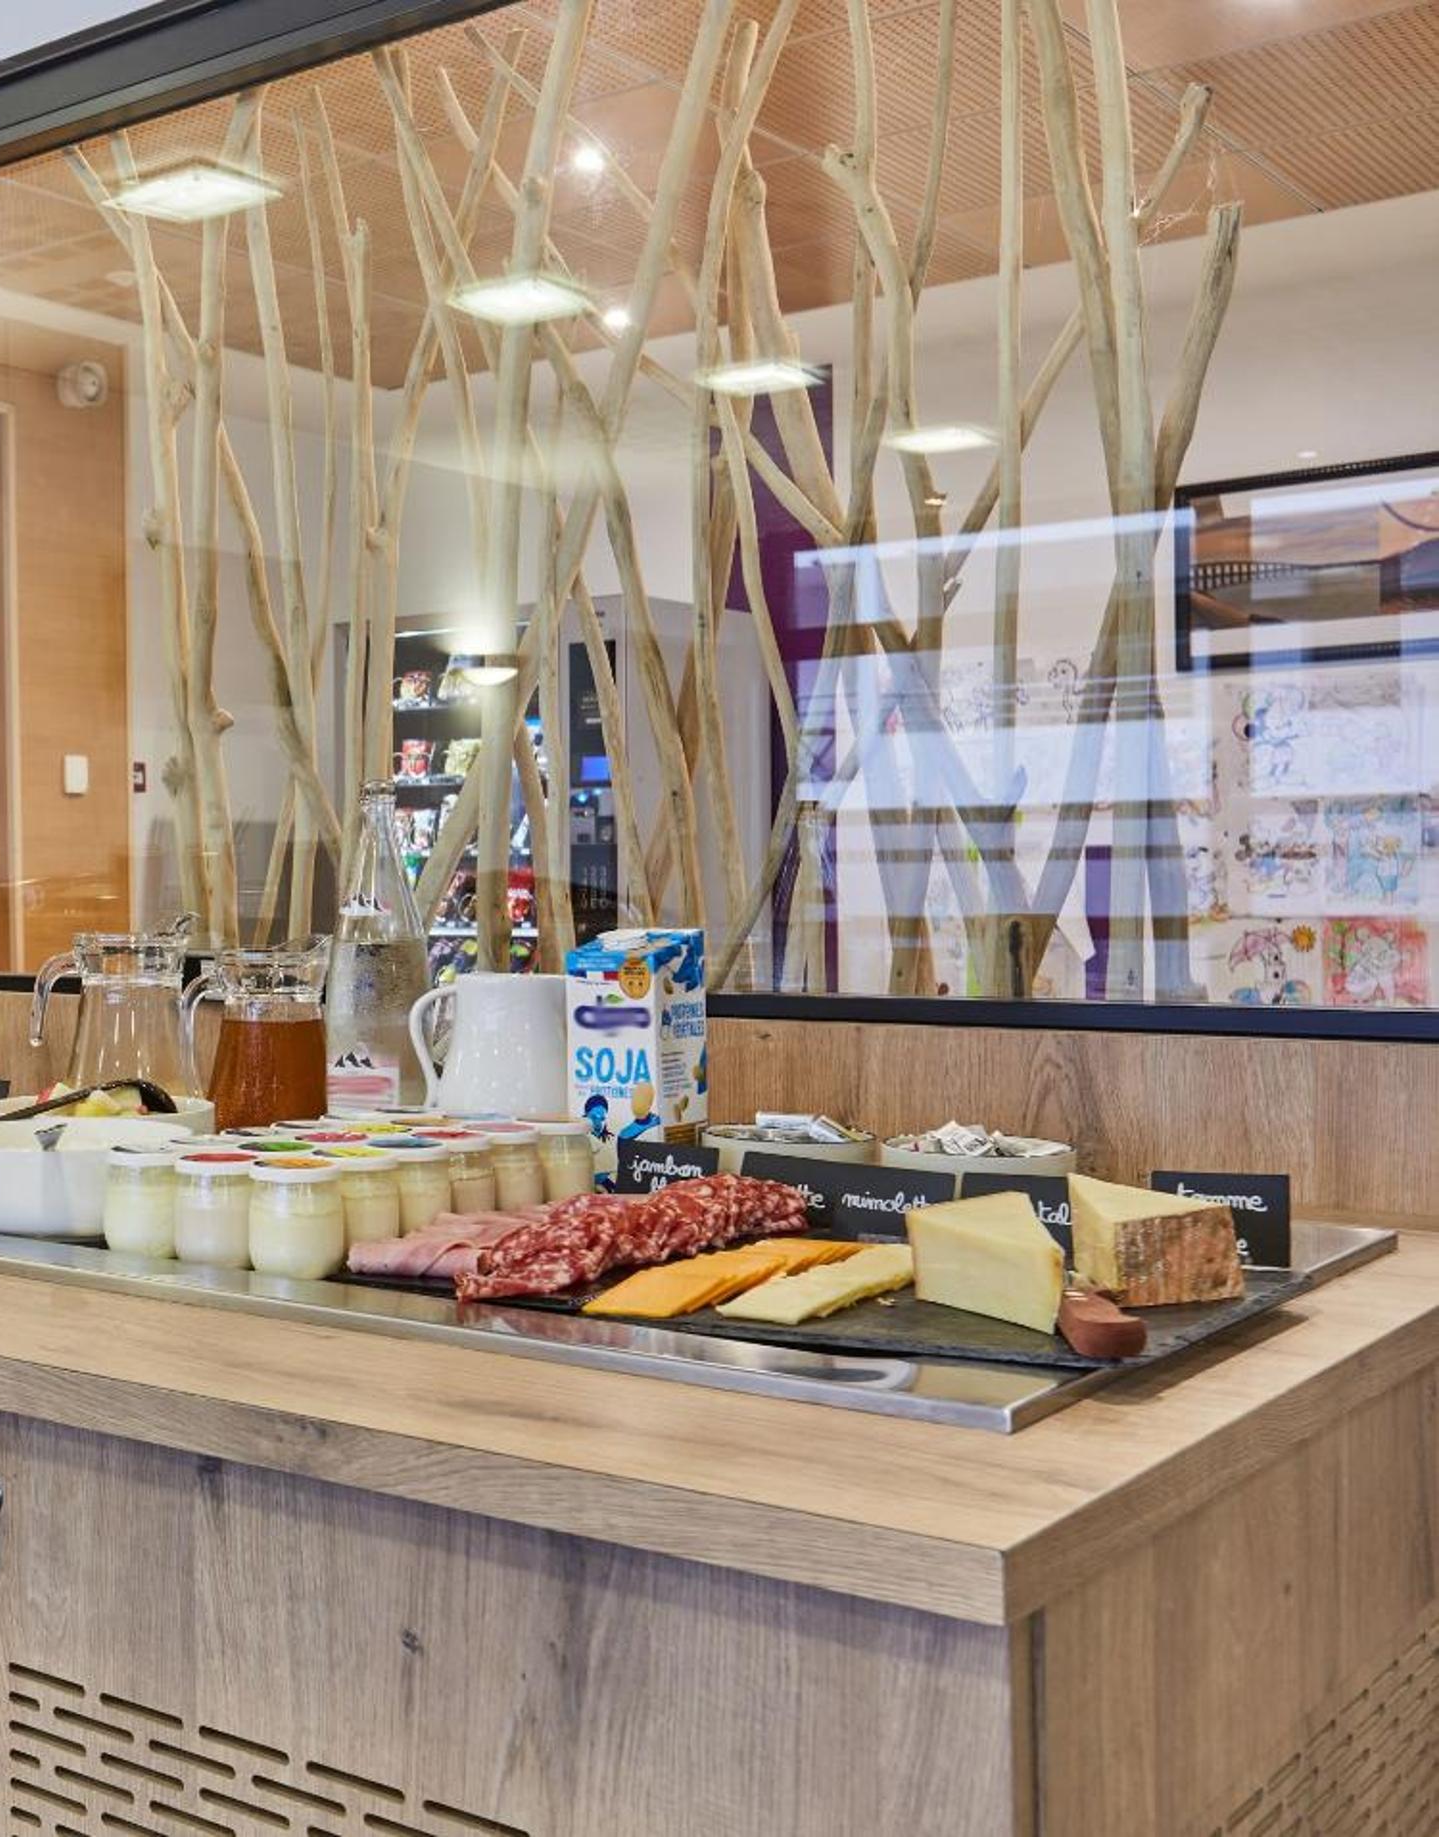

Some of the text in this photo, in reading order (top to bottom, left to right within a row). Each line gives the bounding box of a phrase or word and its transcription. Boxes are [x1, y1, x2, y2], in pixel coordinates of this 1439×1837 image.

[575, 1046, 651, 1084] SOJA
[628, 1154, 705, 1183] jambon
[842, 1191, 929, 1214] mimolett
